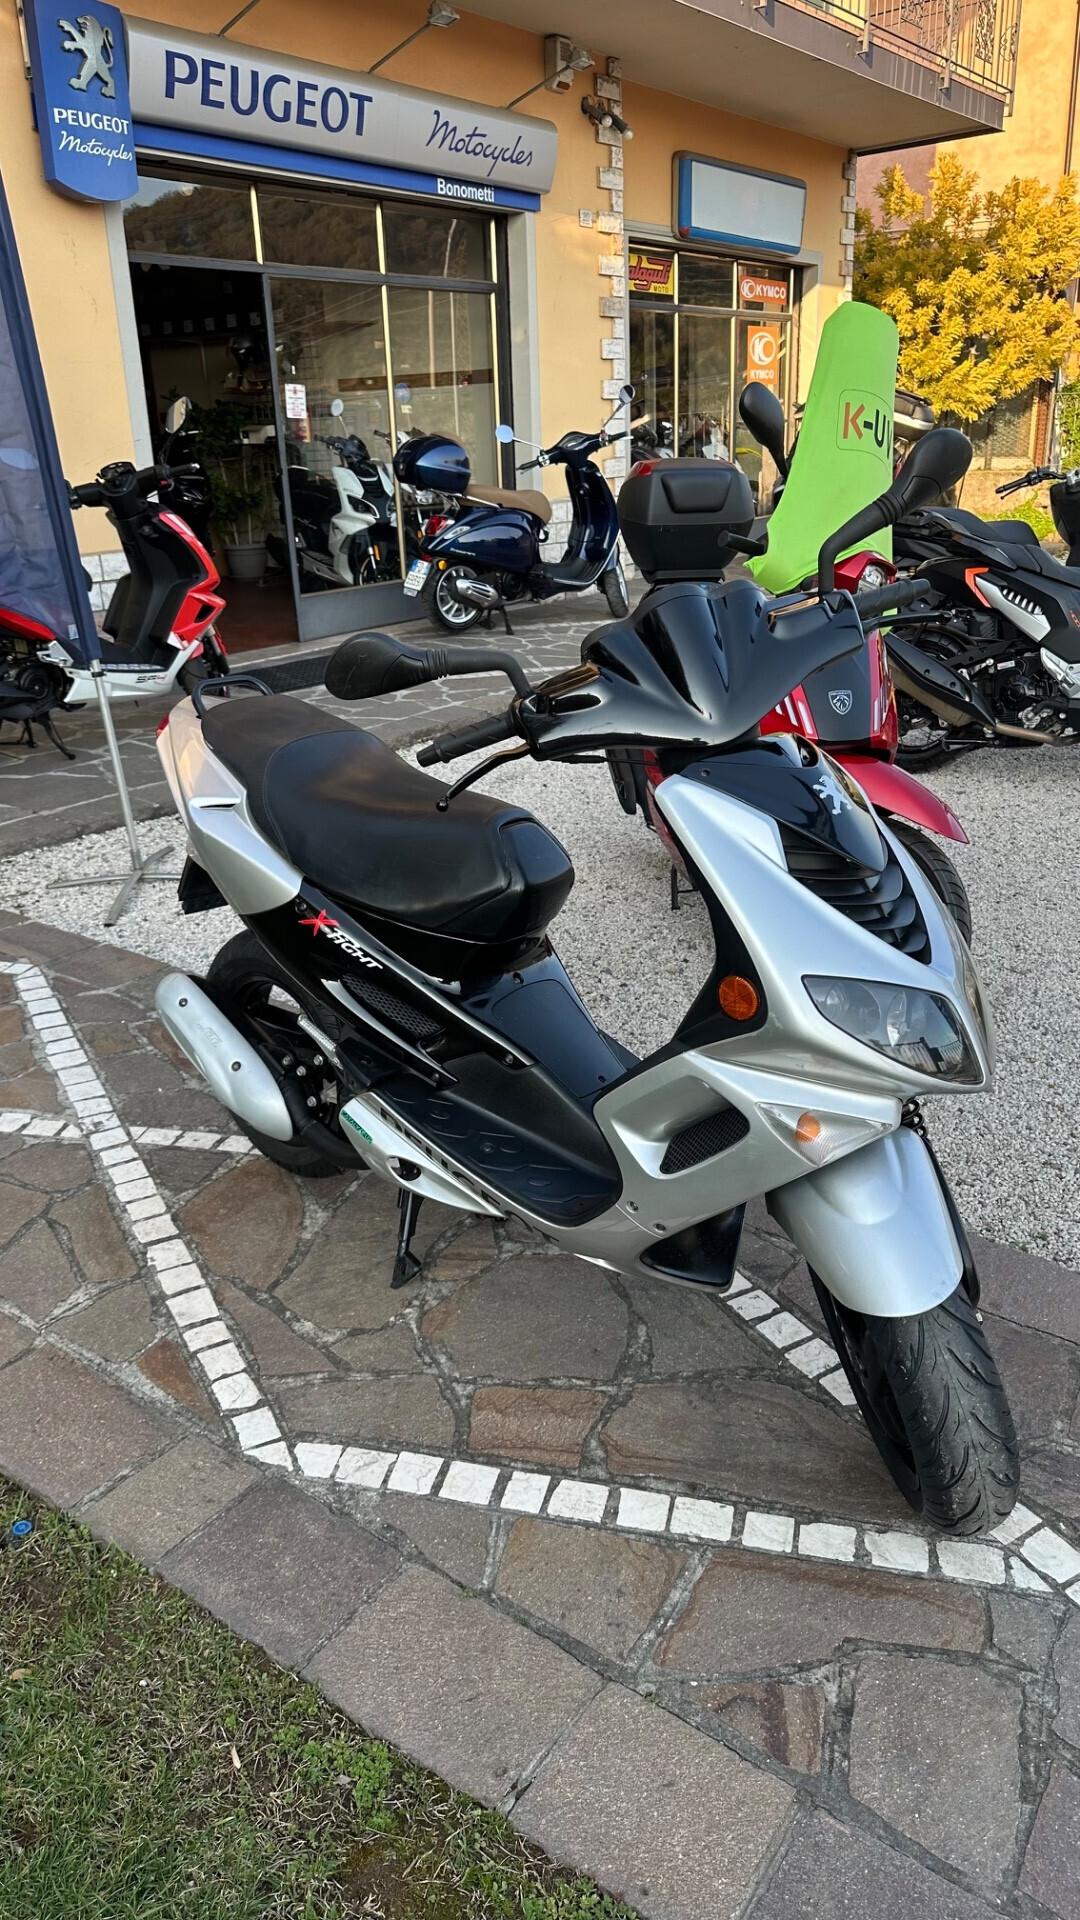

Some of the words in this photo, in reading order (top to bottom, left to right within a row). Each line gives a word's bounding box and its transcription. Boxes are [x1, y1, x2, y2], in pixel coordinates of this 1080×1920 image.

[53, 107, 129, 135] PEUGEOT
[165, 50, 373, 137] PEUGEOT
[425, 109, 533, 177] Motocycles
[58, 130, 133, 167] Motocycles
[436, 177, 495, 203] Bonometti
[756, 284, 786, 300] KYMCO
[750, 368, 775, 380] KYMCO
